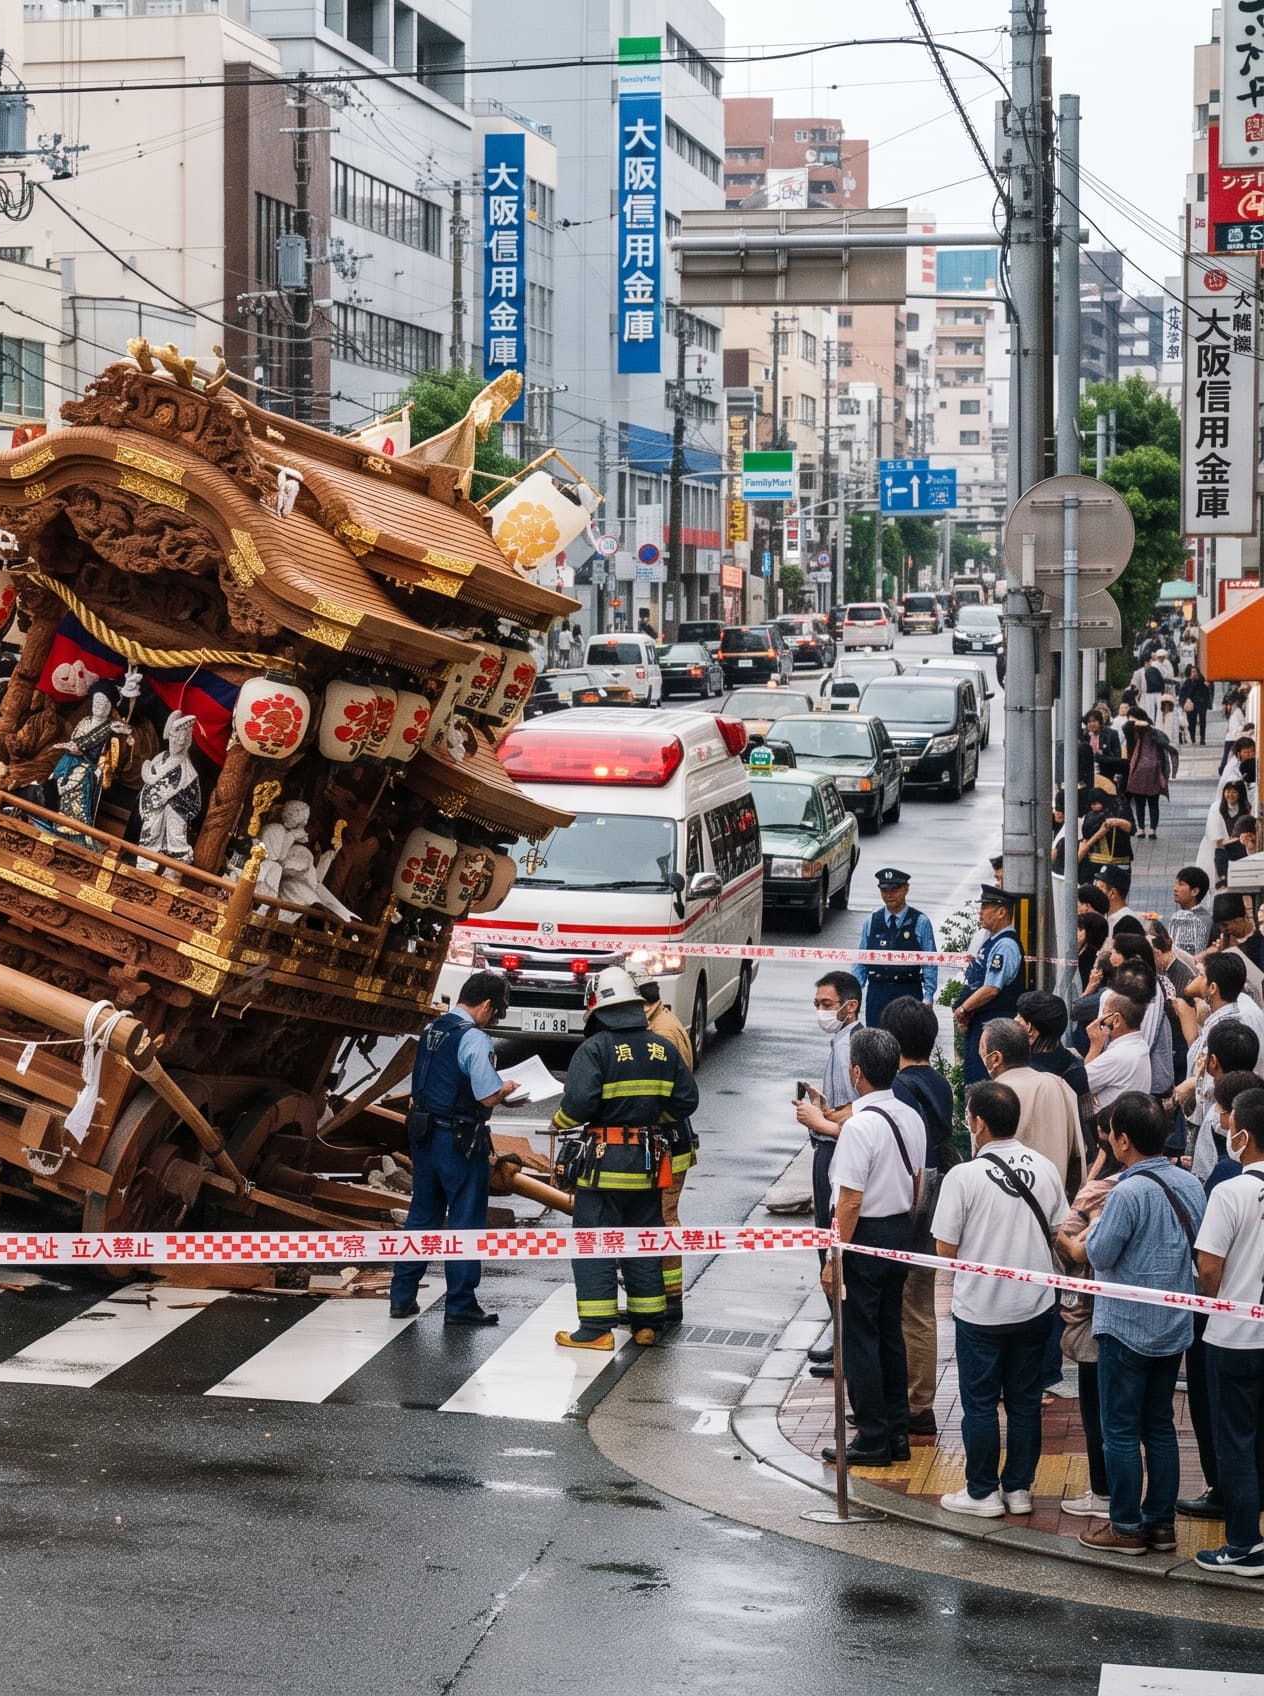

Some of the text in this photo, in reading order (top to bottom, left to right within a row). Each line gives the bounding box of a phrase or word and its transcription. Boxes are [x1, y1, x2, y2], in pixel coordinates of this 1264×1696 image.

[623, 117, 657, 344] 大阪信用金庫
[488, 162, 519, 367] 大阪信用金庫
[1195, 308, 1232, 519] 大阪信用金庫
[745, 478, 792, 488] FamilyMart
[71, 1237, 154, 1258] 立入禁止
[379, 1235, 464, 1256] 立入禁止
[574, 1230, 625, 1254] 警察
[638, 1230, 726, 1251] 立入禁止
